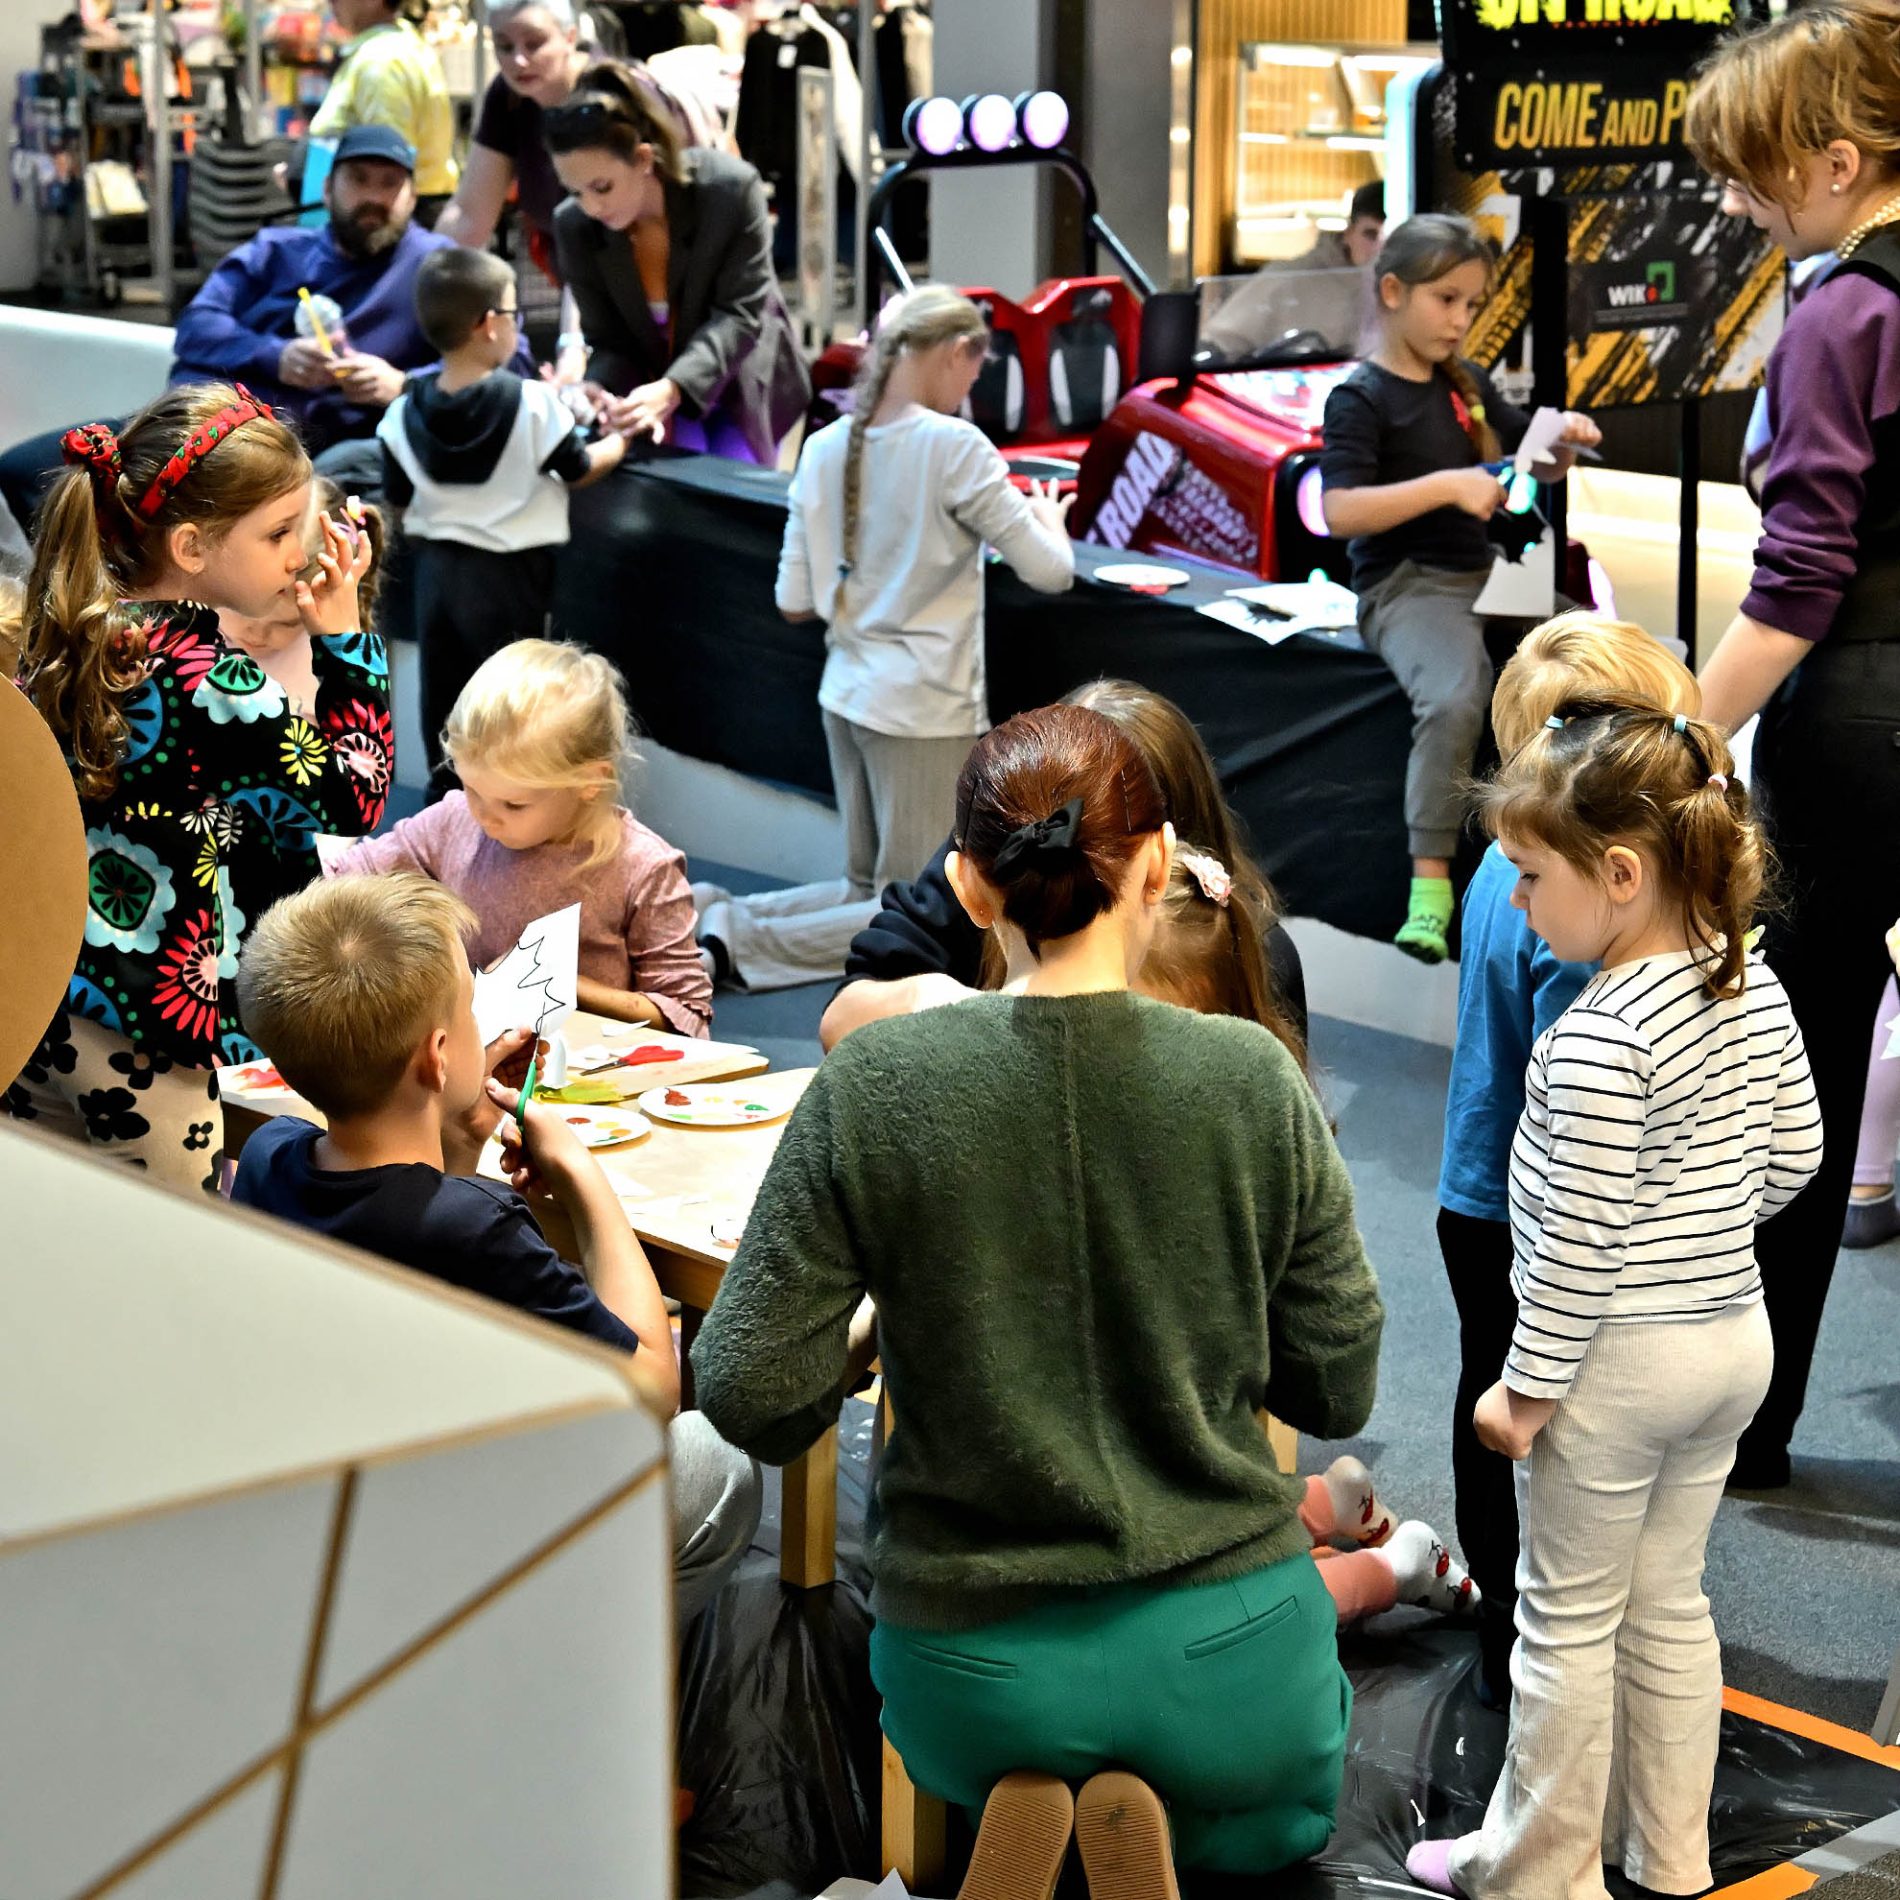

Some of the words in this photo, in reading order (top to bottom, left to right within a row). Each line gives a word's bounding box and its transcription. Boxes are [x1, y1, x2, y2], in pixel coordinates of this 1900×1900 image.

[1495, 82, 1602, 149] COME
[1602, 99, 1657, 146] AND
[1086, 430, 1176, 549] ROAD
